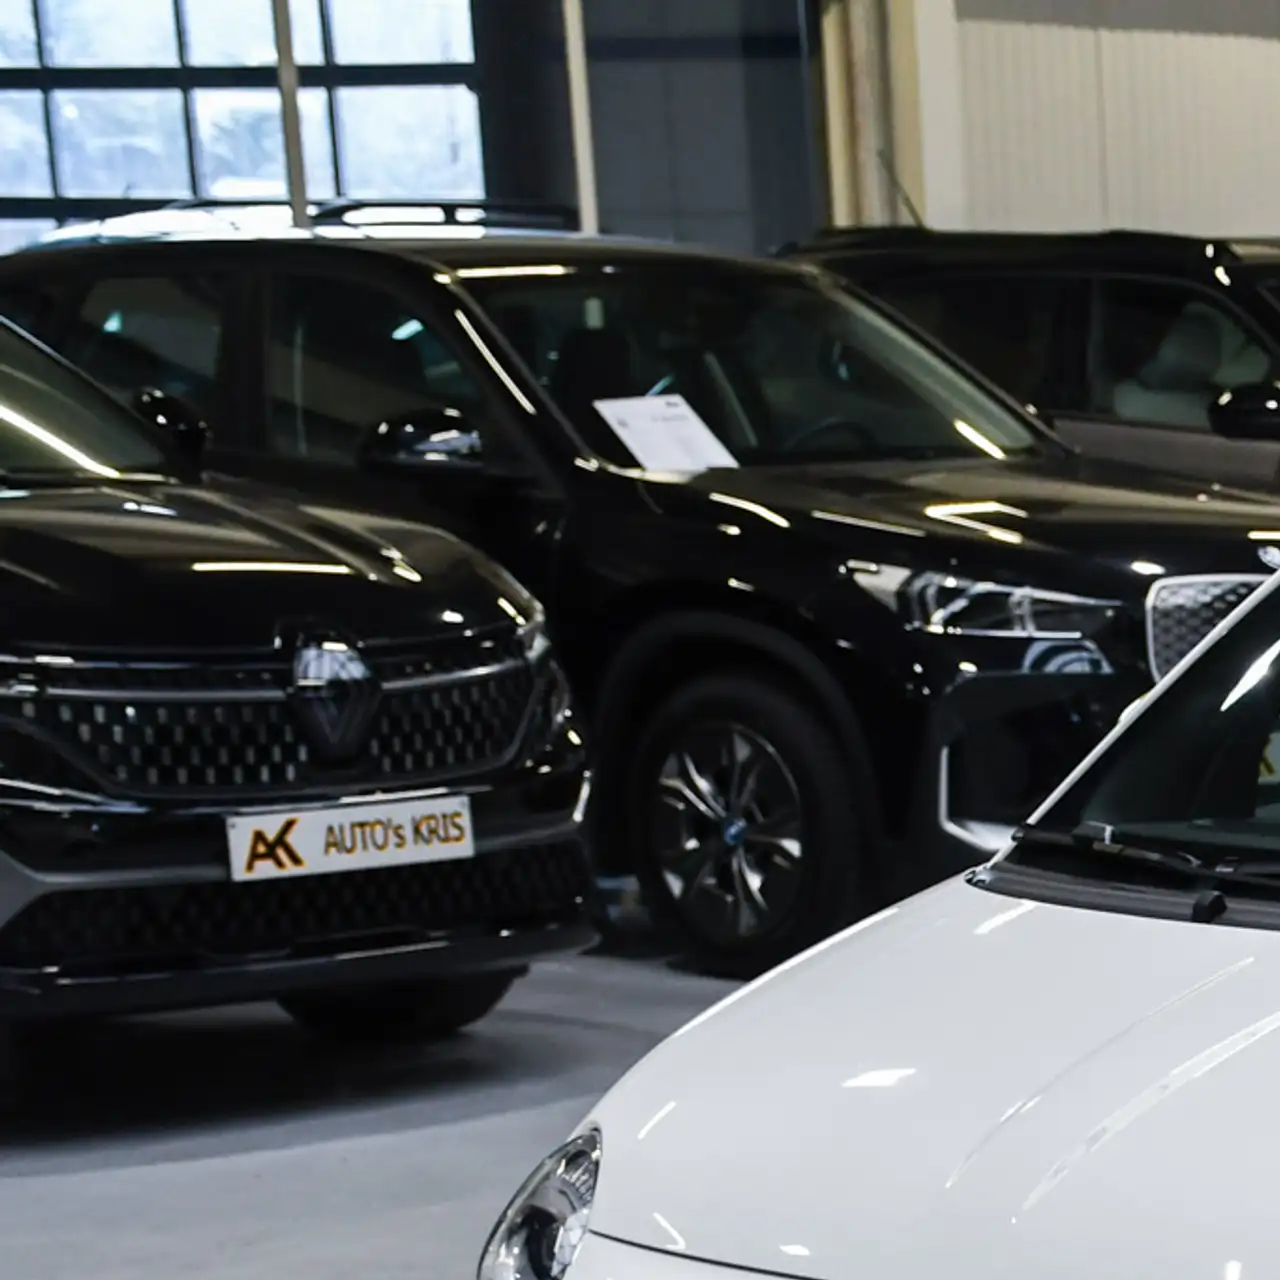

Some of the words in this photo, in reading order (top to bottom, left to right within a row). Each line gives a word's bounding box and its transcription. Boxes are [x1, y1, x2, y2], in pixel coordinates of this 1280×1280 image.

[244, 817, 307, 874] AK
[323, 817, 406, 856] AUTO's
[410, 811, 466, 846] KRIS
